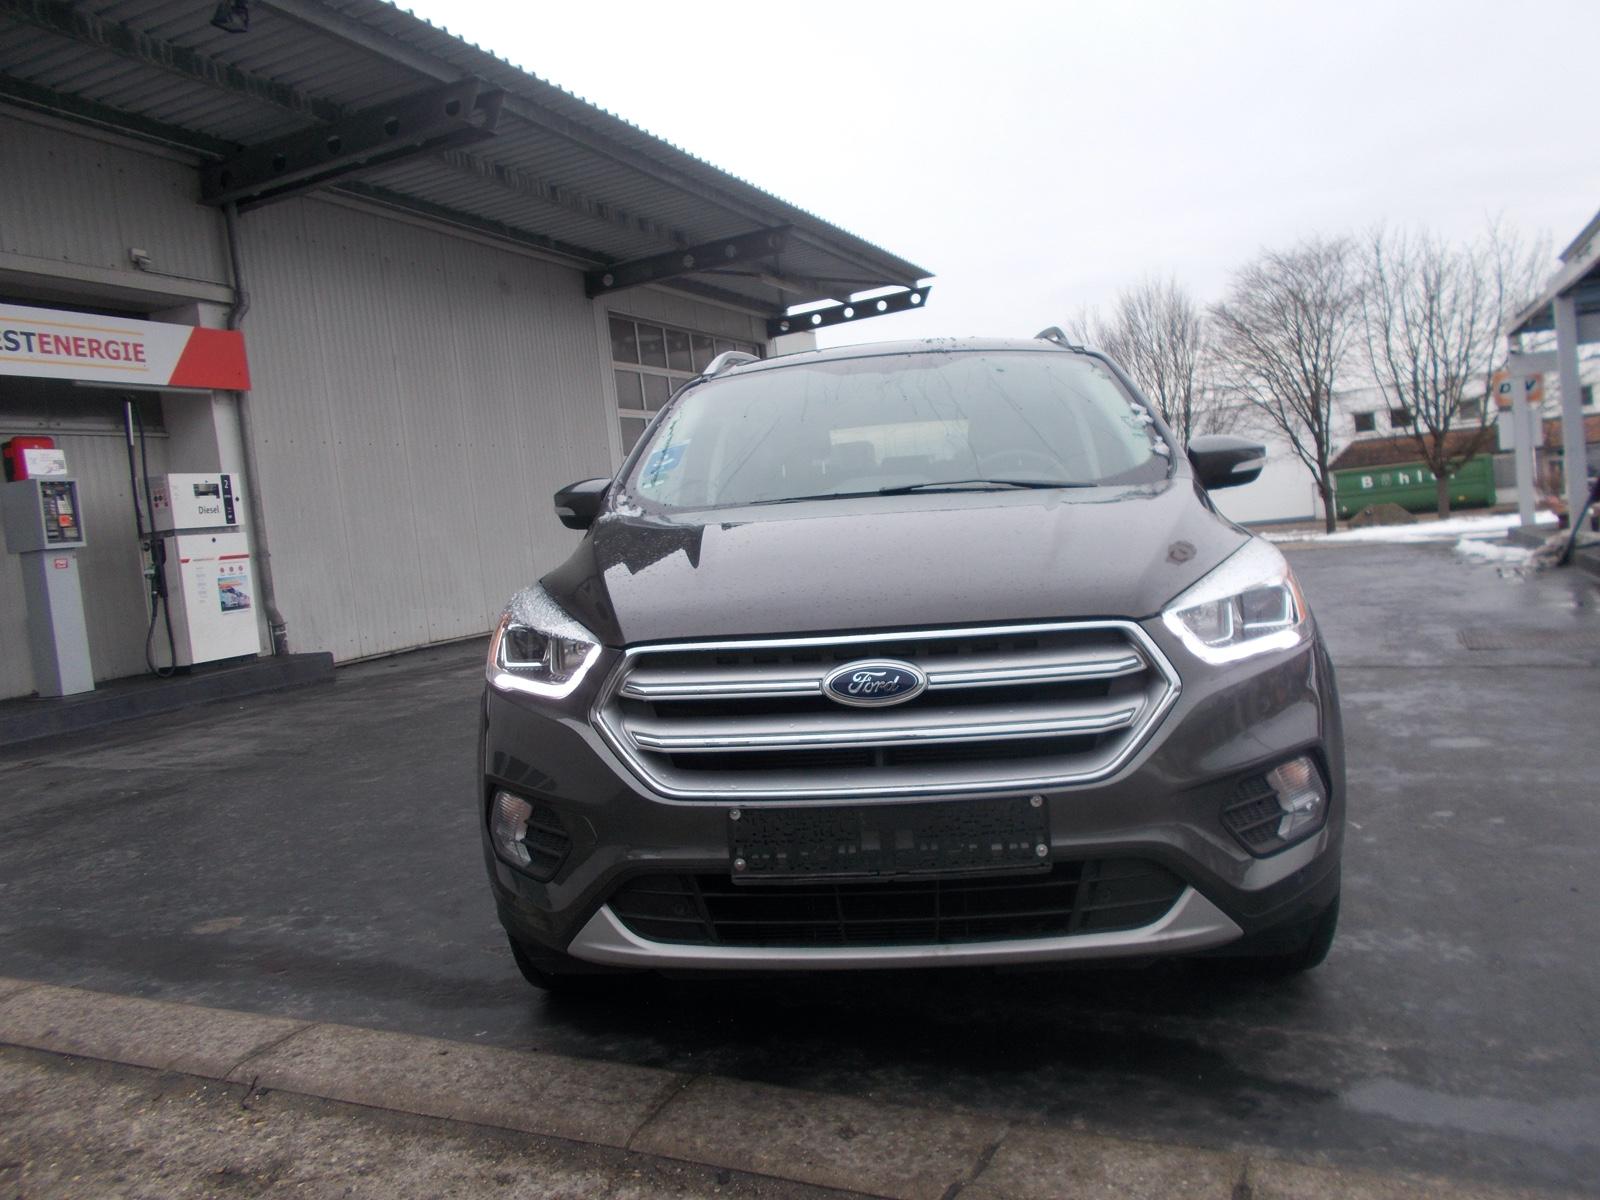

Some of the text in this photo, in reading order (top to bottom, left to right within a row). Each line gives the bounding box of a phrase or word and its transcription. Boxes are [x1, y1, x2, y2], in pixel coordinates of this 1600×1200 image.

[0, 329, 146, 363] STENERGIE
[1499, 380, 1536, 394] DV
[223, 479, 229, 489] 2
[198, 505, 220, 514] Diesel
[847, 671, 900, 694] Ford
